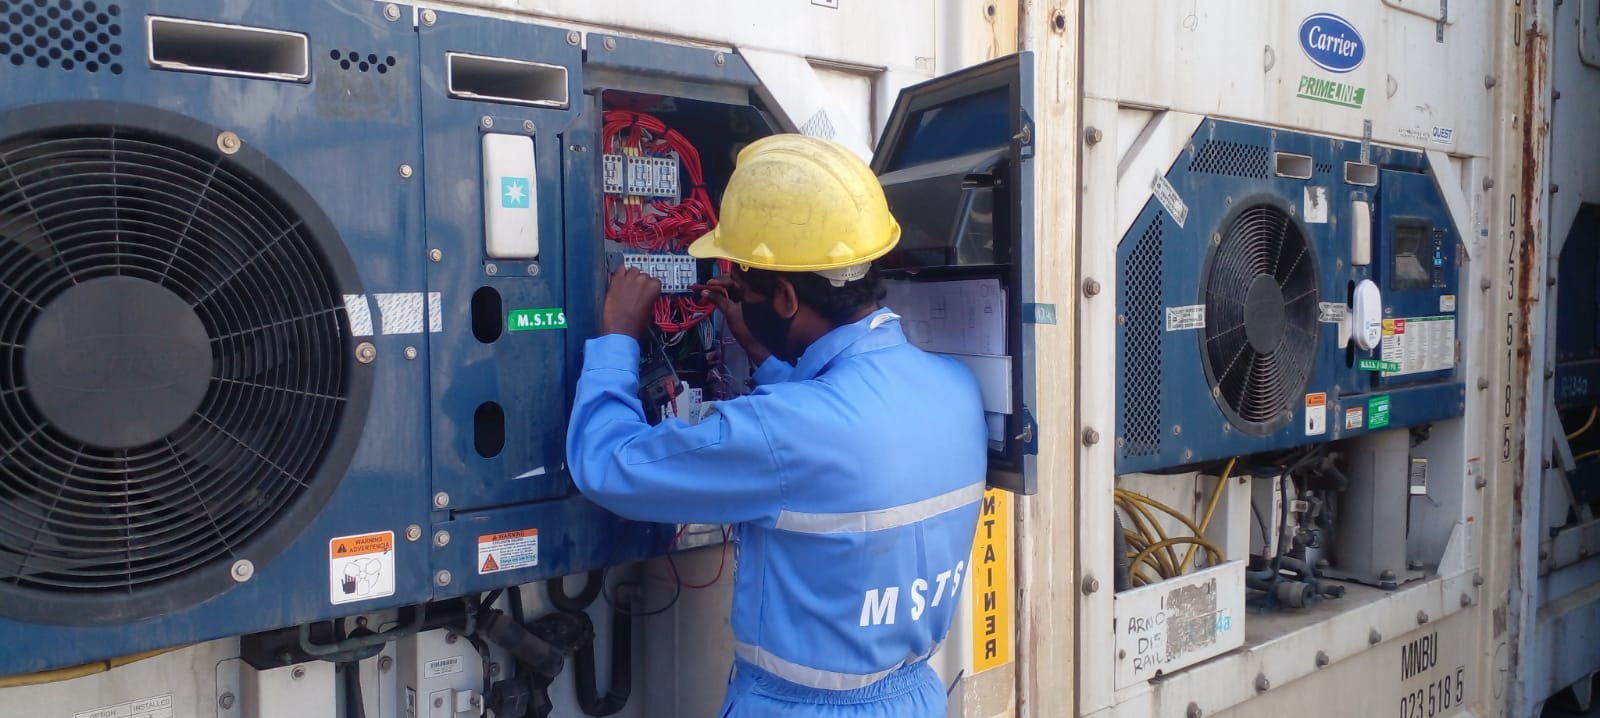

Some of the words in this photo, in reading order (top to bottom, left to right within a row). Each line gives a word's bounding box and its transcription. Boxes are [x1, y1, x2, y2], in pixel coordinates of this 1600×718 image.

[1309, 25, 1357, 57] Carrier
[1433, 126, 1452, 139] QUEST
[354, 536, 383, 545] WARNING
[1401, 632, 1437, 681] MNBU
[134, 699, 170, 712] INSTALLED
[1428, 675, 1451, 717] 518
